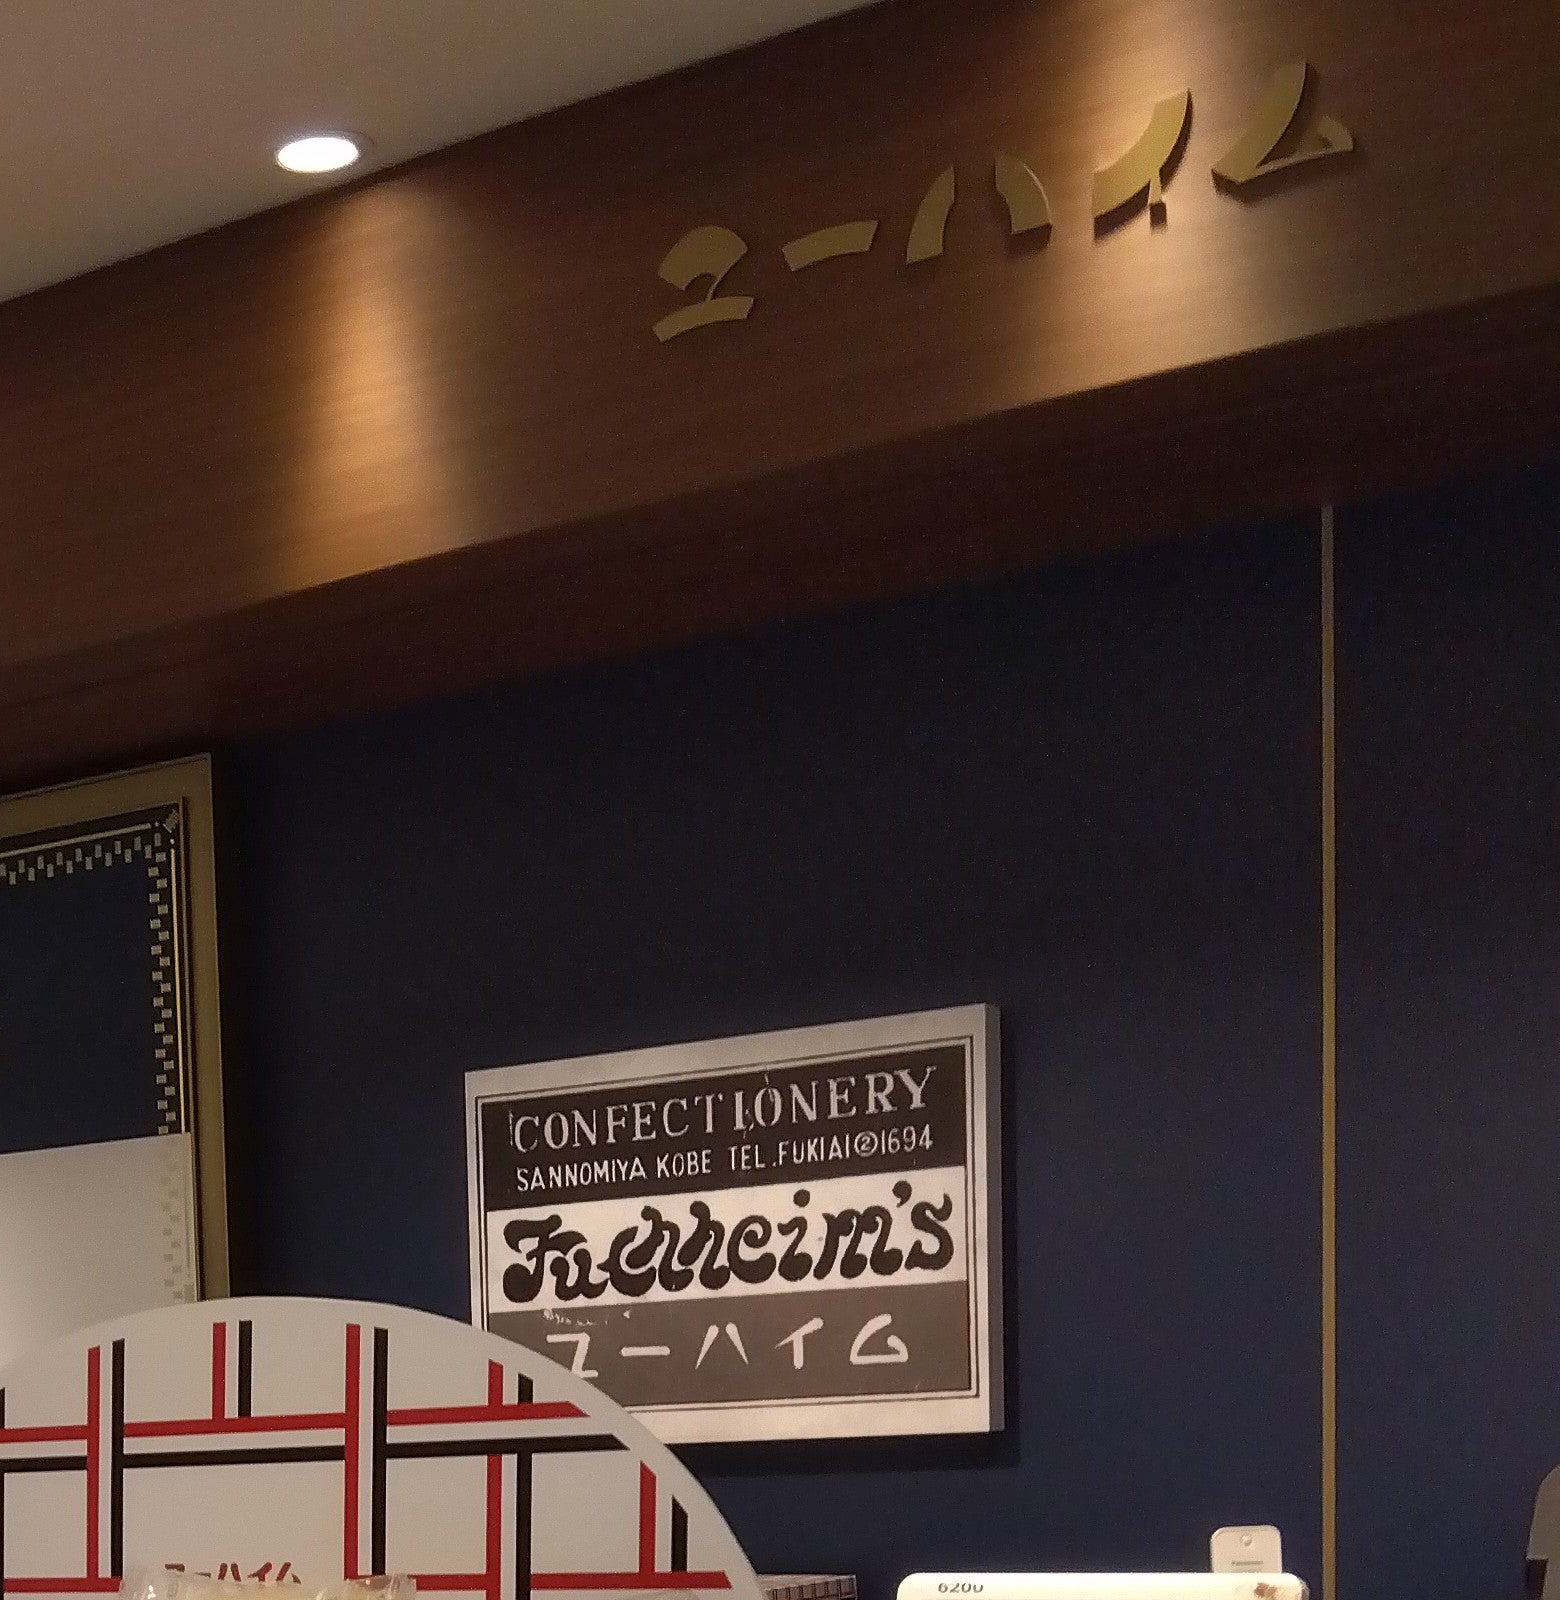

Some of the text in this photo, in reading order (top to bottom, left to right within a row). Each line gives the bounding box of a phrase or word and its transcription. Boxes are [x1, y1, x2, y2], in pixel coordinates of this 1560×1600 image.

[651, 60, 1354, 343] ユーハイム
[514, 1065, 937, 1153] CONFECTIONERY
[516, 1159, 648, 1193] SANNOMIYA
[656, 1149, 713, 1178] KOBE
[502, 1180, 956, 1303] Juchheim's
[546, 1313, 910, 1379] ユーハイム
